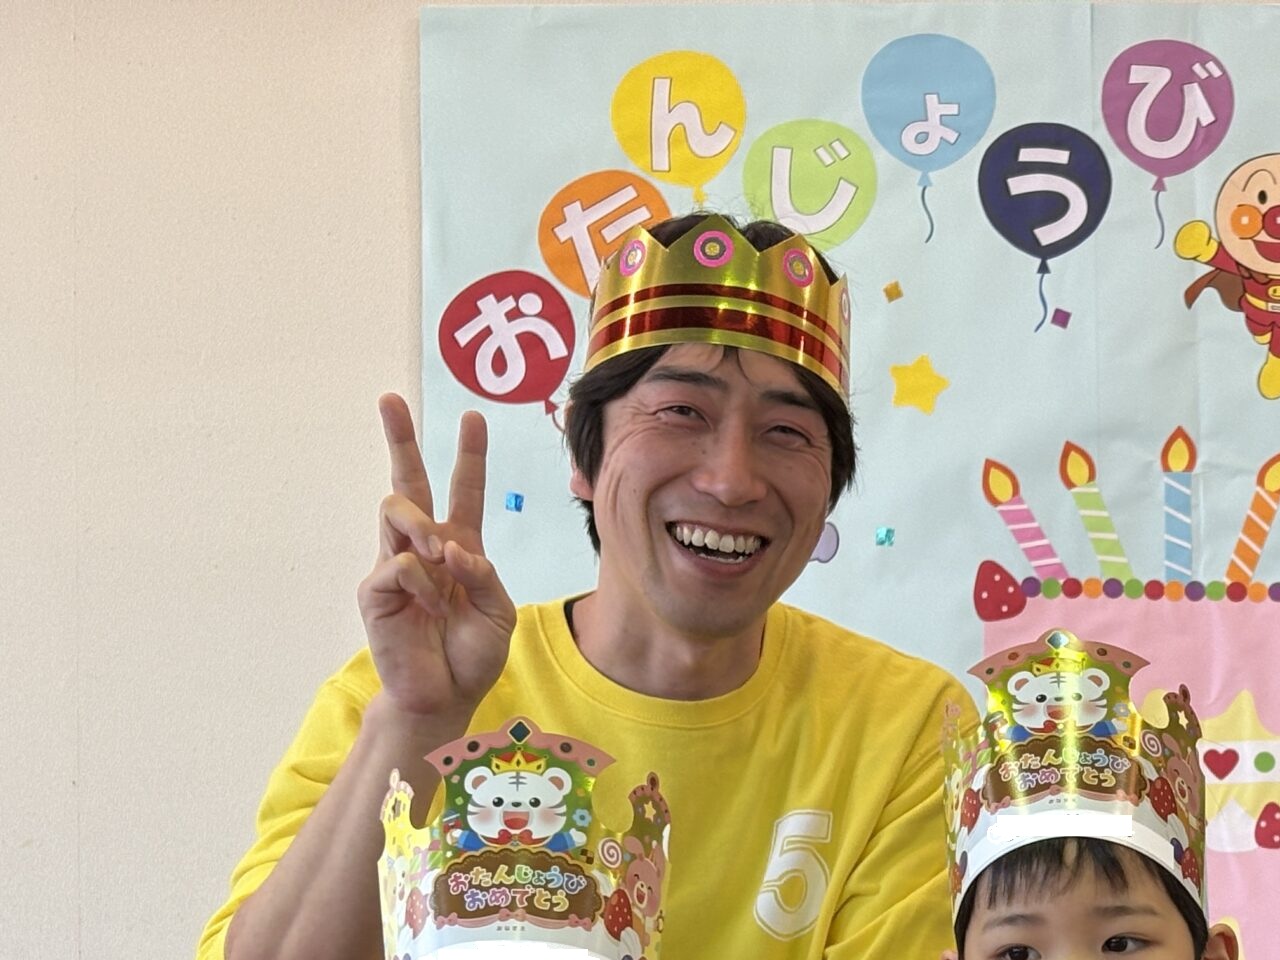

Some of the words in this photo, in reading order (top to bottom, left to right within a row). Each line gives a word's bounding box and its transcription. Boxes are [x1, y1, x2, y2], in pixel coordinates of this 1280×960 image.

[999, 748, 1129, 782] おたんじょうび
[1017, 765, 1116, 791] おめでとう
[449, 864, 587, 895] おたんじょうび
[754, 809, 833, 941] 5
[464, 886, 569, 911] おめでとう
